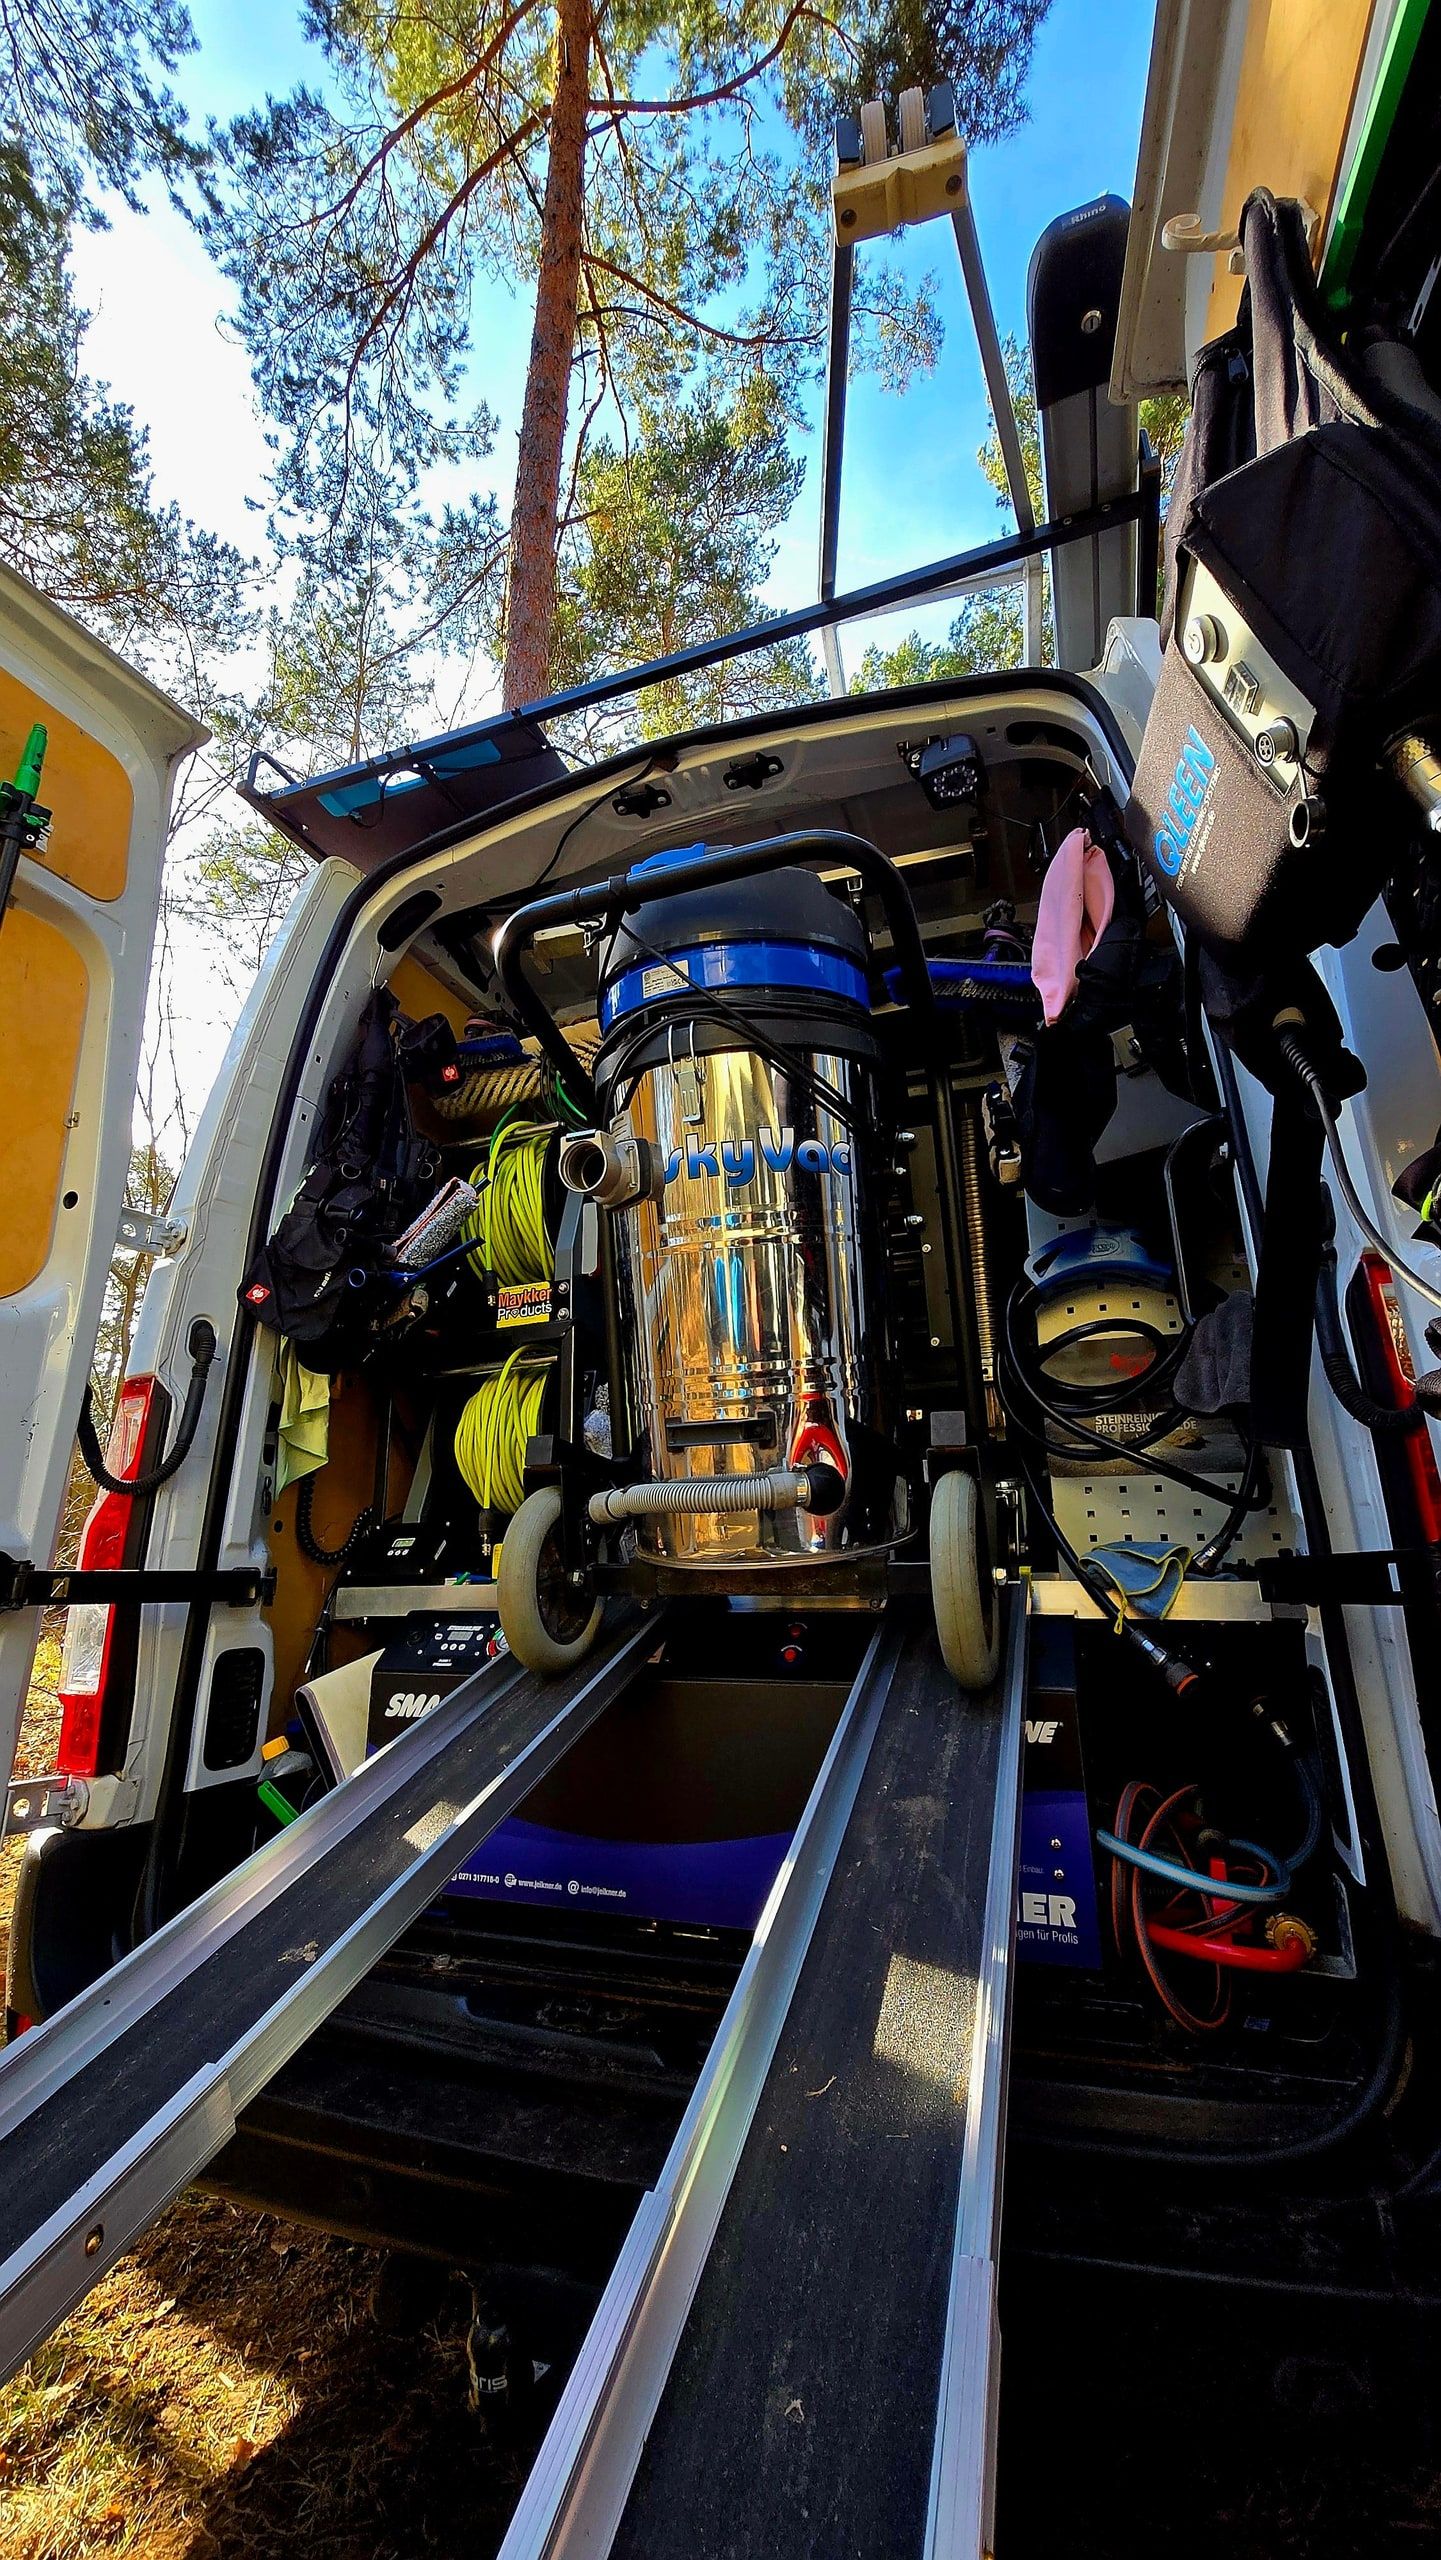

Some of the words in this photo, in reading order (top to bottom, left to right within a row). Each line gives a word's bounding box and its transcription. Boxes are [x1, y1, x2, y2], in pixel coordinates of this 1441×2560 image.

[1070, 204, 1107, 225] Rhino
[1154, 723, 1215, 877] QLEEN
[1190, 809, 1217, 875] www.qleen.de
[1180, 845, 1194, 873] WATER
[498, 1287, 553, 1310] Maykker
[497, 1301, 553, 1321] Products
[1095, 1412, 1161, 1426] STEINREINI
[1017, 1891, 1077, 1929] ER
[1036, 1928, 1050, 1941] für
[1051, 1930, 1079, 1945] Profis
